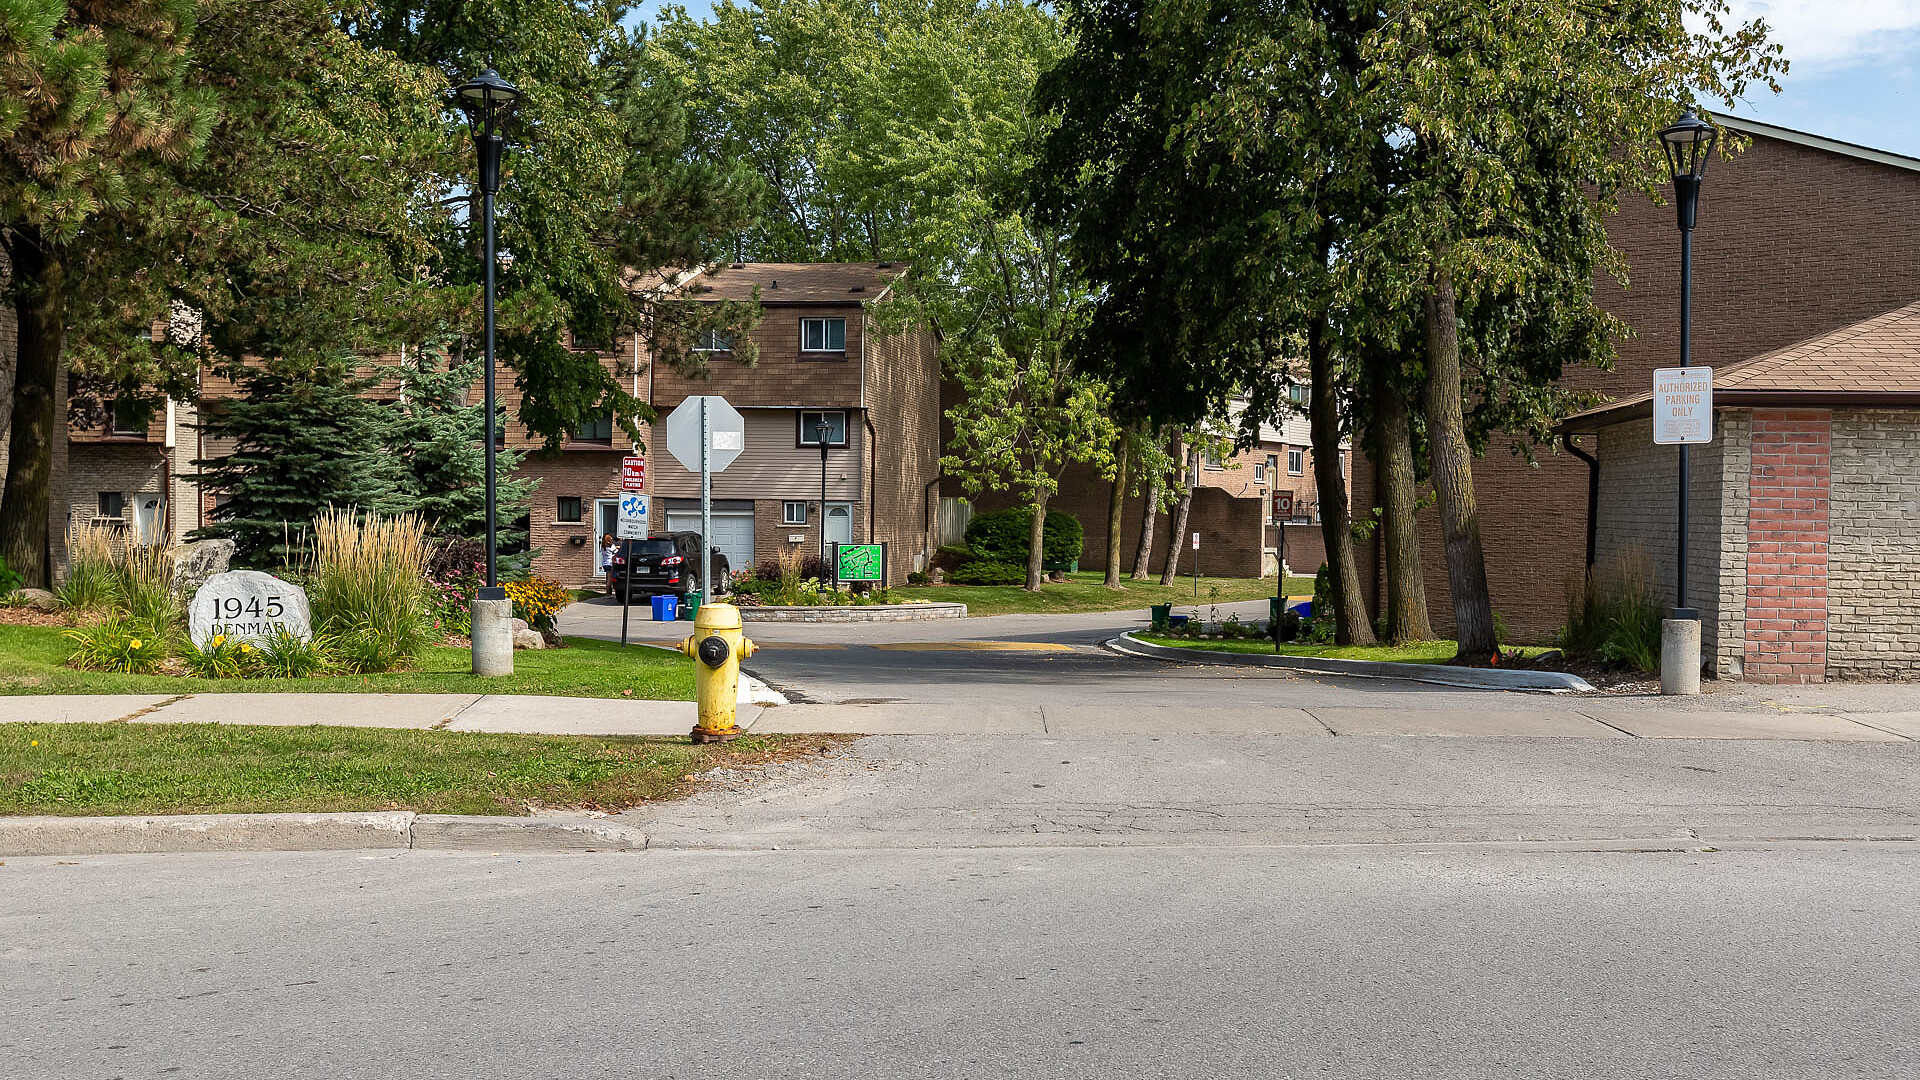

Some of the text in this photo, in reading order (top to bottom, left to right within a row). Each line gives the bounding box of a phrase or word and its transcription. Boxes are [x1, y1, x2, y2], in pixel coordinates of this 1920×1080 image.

[1658, 381, 1708, 394] AUTHORIZED
[1665, 395, 1701, 405] PARKING
[1672, 406, 1693, 417] ONLY
[624, 467, 632, 476] 10
[1275, 498, 1290, 510] 10
[213, 596, 284, 619] 1945
